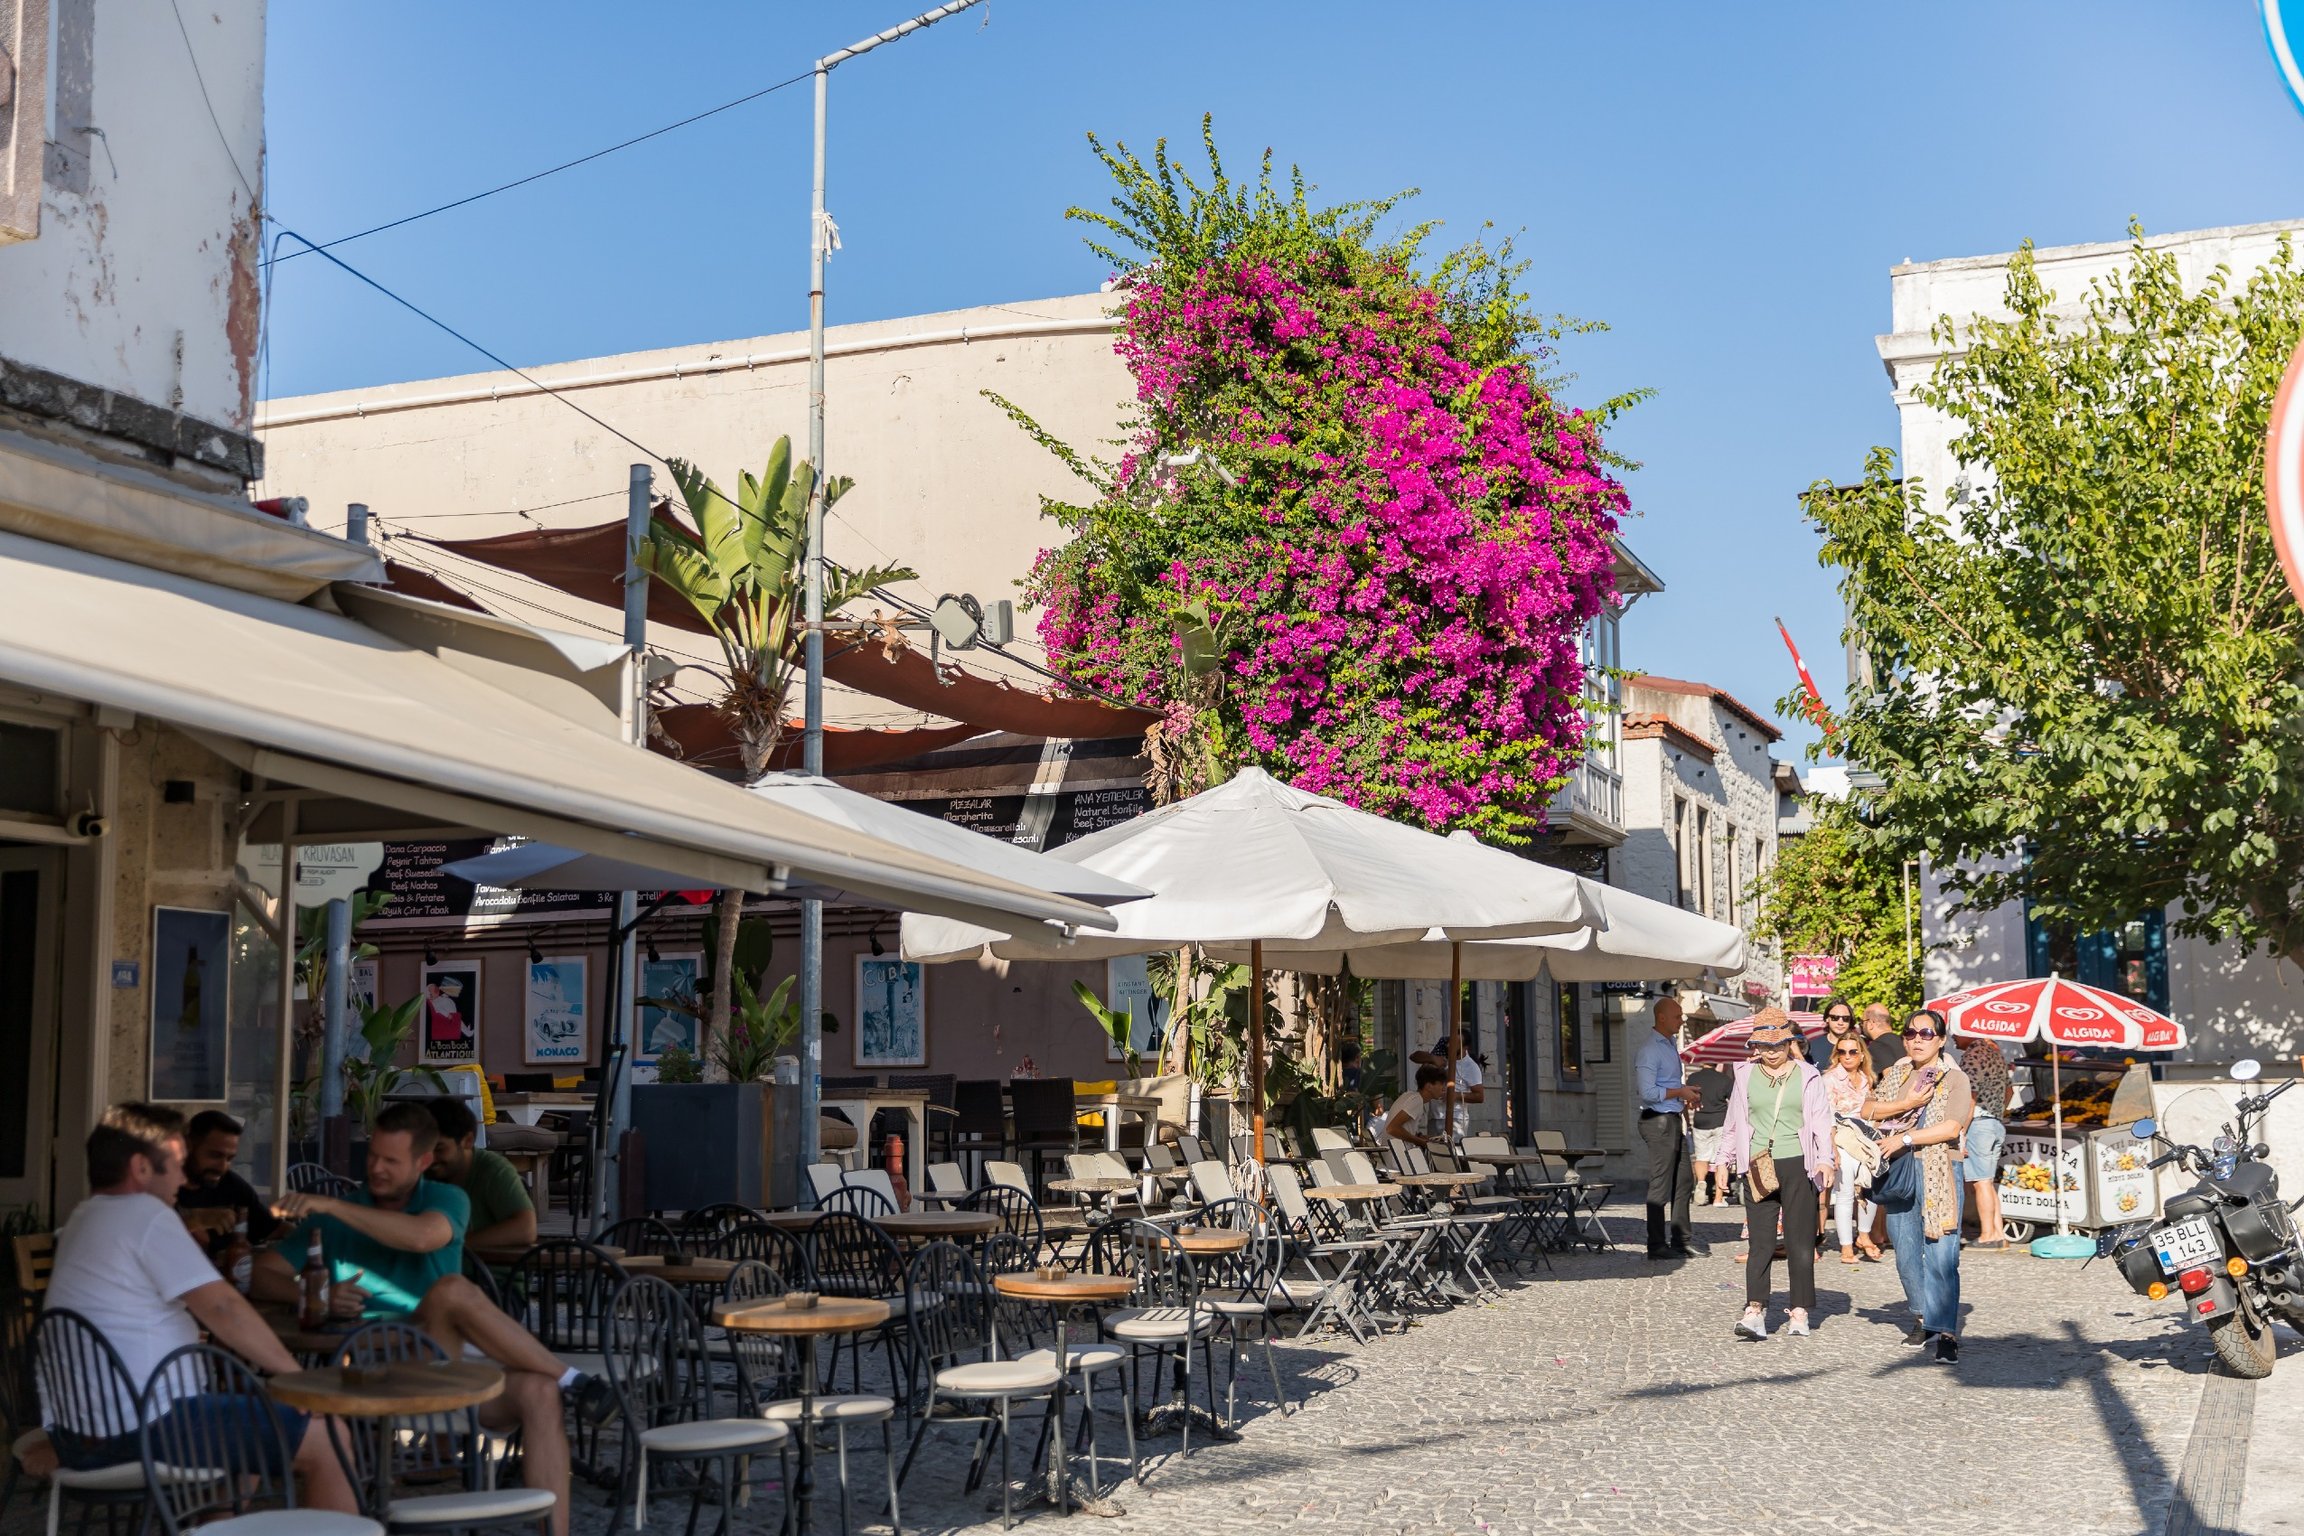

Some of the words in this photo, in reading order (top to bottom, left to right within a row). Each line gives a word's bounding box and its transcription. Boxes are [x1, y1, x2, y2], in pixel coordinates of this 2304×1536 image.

[1074, 793, 1094, 805] ANA
[1095, 789, 1144, 803] YEMEKLER
[1074, 805, 1110, 817] Naturel
[1112, 803, 1144, 816] Bonfile
[943, 811, 994, 823] Margherita
[1073, 817, 1095, 829] Beef
[303, 846, 355, 863] KRUVASAN
[385, 845, 405, 853] Dana
[407, 844, 447, 854] Carpaccio
[387, 856, 413, 867] Peynir
[385, 868, 403, 879] Beef
[391, 881, 409, 892] Beef
[410, 880, 438, 890] Nachos
[415, 893, 445, 902] Patates
[547, 892, 580, 902] Salatası
[424, 905, 450, 915] Tabak
[863, 963, 909, 987] CUBA
[425, 1048, 475, 1059] ATLANTIQUE
[535, 1047, 579, 1057] MONACO
[2039, 1143, 2079, 1169] USTA
[2001, 1192, 2032, 1206] MİDYE
[2155, 1231, 2175, 1248] 35
[2176, 1223, 2206, 1240] BLL
[2179, 1239, 2206, 1257] 143
